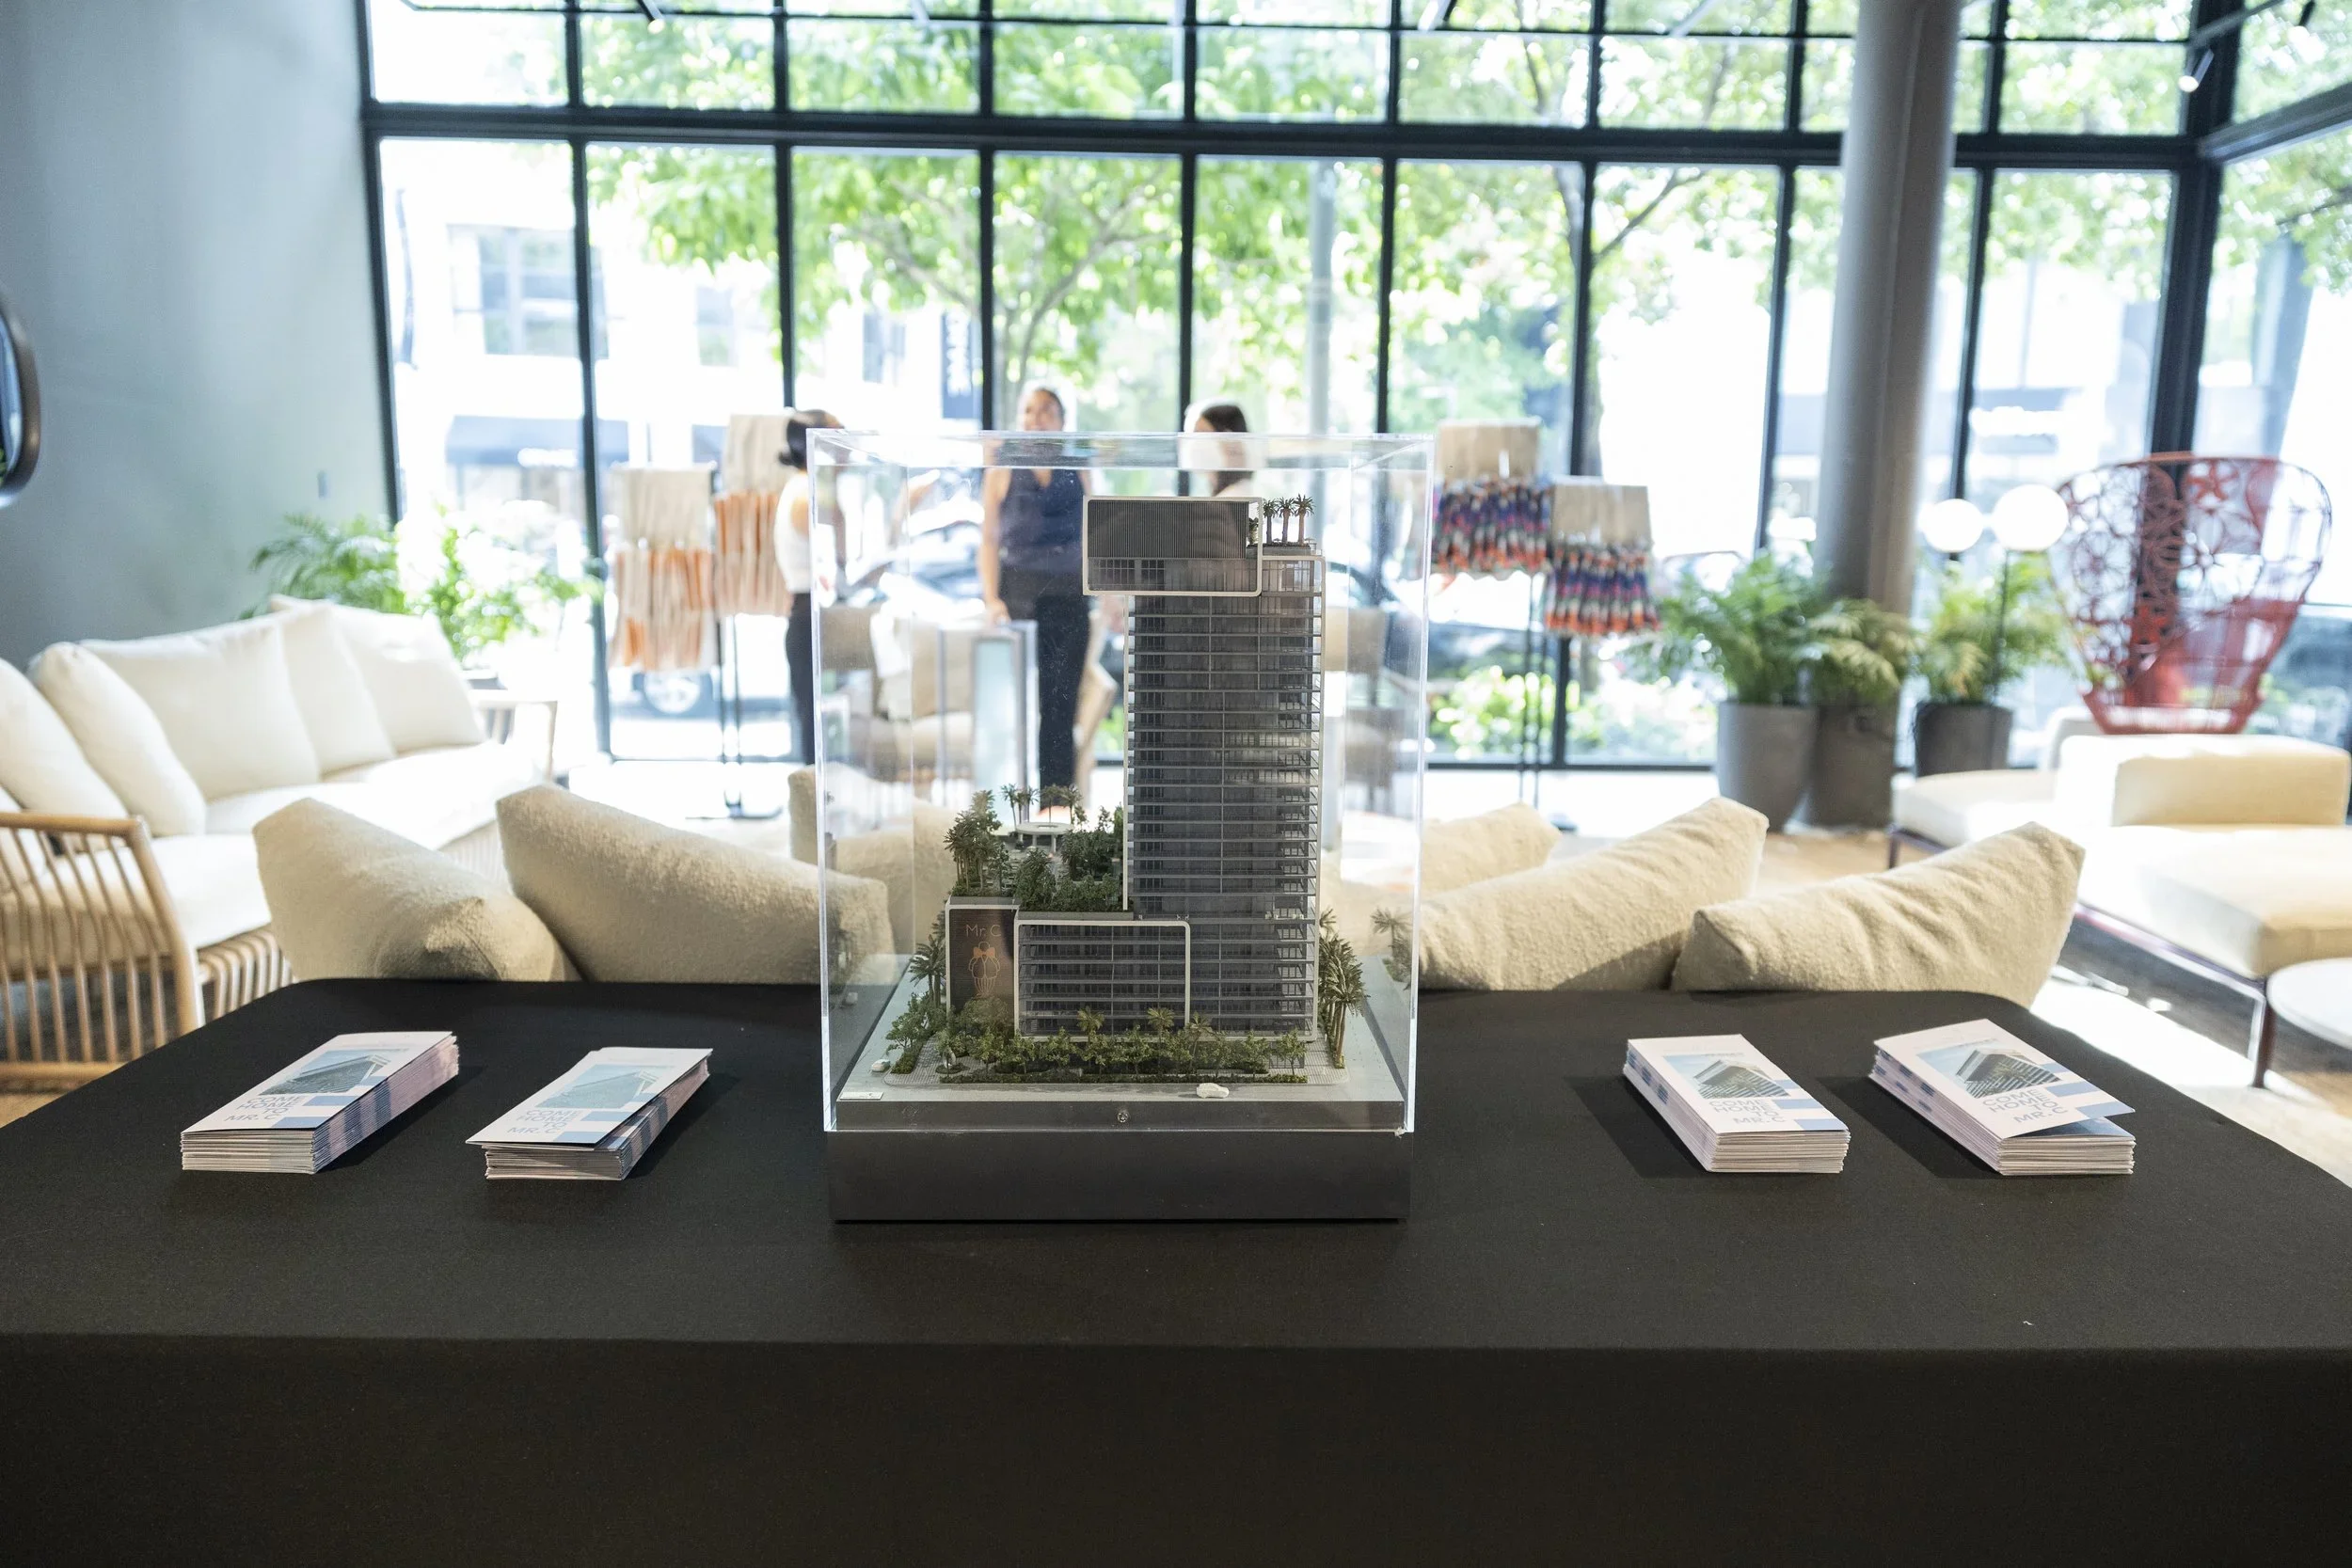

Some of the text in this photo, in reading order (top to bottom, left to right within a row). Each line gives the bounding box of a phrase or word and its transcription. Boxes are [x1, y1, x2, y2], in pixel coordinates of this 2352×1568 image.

[990, 924, 1002, 937] C
[1982, 1089, 2038, 1106] COME
[236, 1101, 295, 1110] HOME
[1989, 1096, 2050, 1113] HOME
[2032, 1101, 2058, 1111] TO
